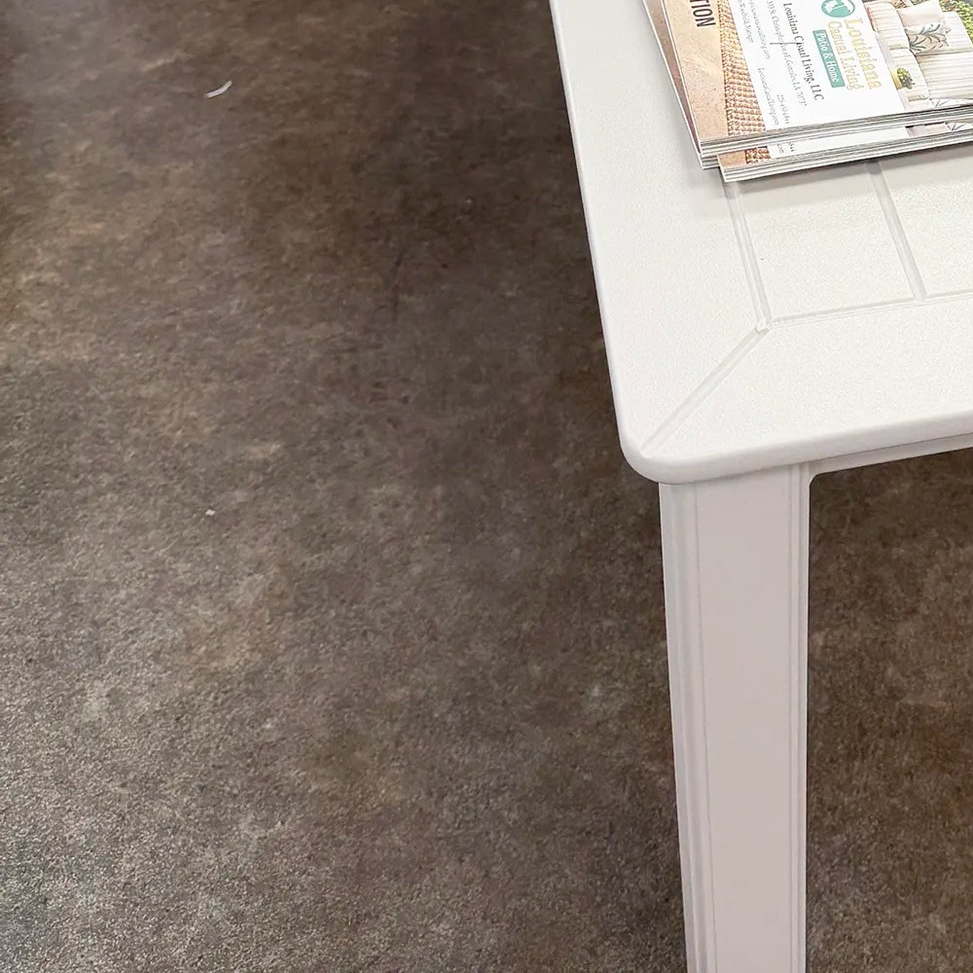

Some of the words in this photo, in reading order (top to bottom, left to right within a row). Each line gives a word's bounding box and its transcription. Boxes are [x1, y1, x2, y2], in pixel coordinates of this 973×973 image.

[783, 2, 799, 35] Louisiana
[810, 84, 825, 101] LLC
[815, 31, 830, 51] Patio
[822, 52, 833, 60] &
[828, 20, 850, 55] Casual
[840, 56, 864, 90] Living
[844, 17, 882, 90] Louisiana
[826, 61, 839, 83] Home
